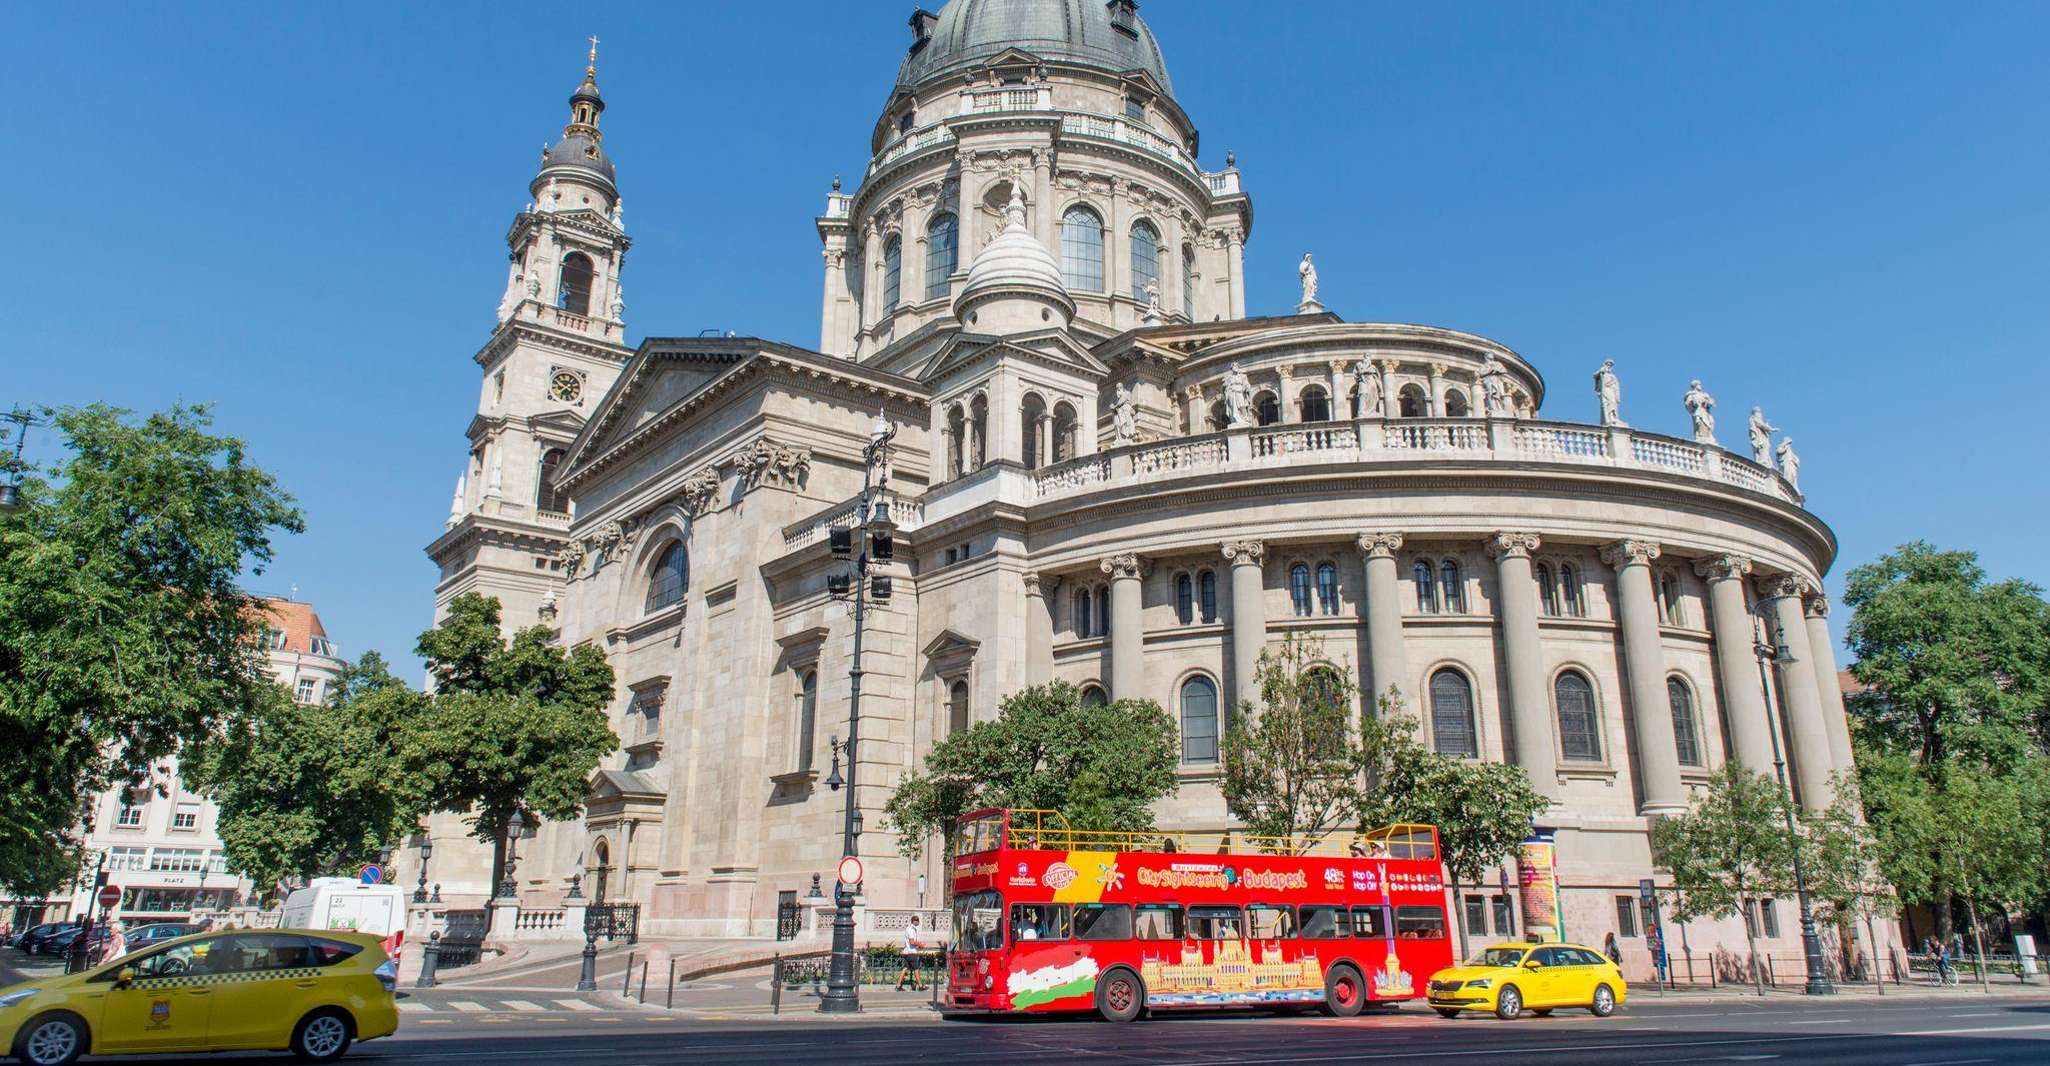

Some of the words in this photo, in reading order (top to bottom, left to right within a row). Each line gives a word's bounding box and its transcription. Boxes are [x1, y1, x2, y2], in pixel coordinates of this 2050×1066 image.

[1045, 870, 1078, 885] OFFICIAL
[1138, 867, 1228, 891] CitySightseeing
[1243, 868, 1308, 892] Budapest
[1324, 867, 1337, 883] 48
[1352, 870, 1365, 880] Hop
[1366, 870, 1375, 880] On
[1353, 881, 1366, 891] Hop
[1367, 881, 1377, 891] Off
